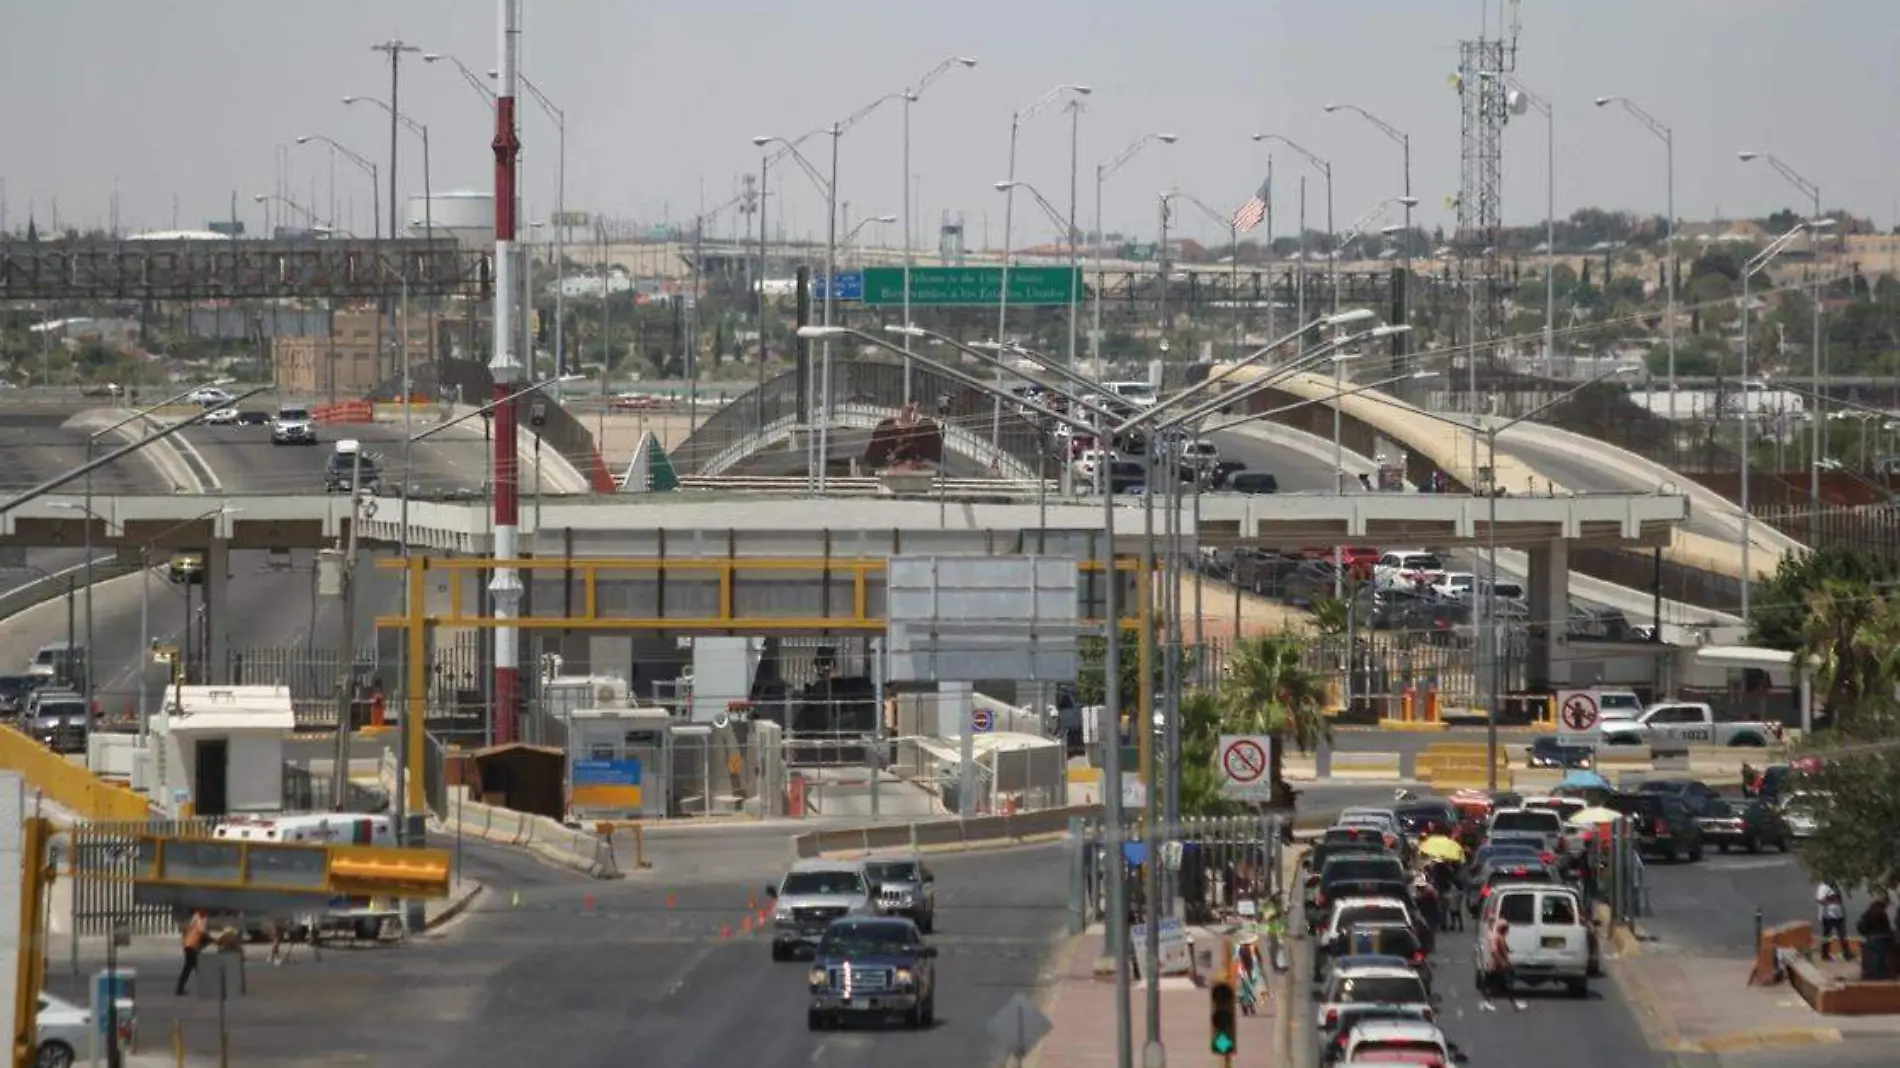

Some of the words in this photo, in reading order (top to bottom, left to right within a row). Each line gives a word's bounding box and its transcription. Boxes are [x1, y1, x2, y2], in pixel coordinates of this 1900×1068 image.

[881, 287, 946, 299] Bienenidos
[980, 288, 1022, 299] Estaos
[1682, 731, 1709, 741] 1023
